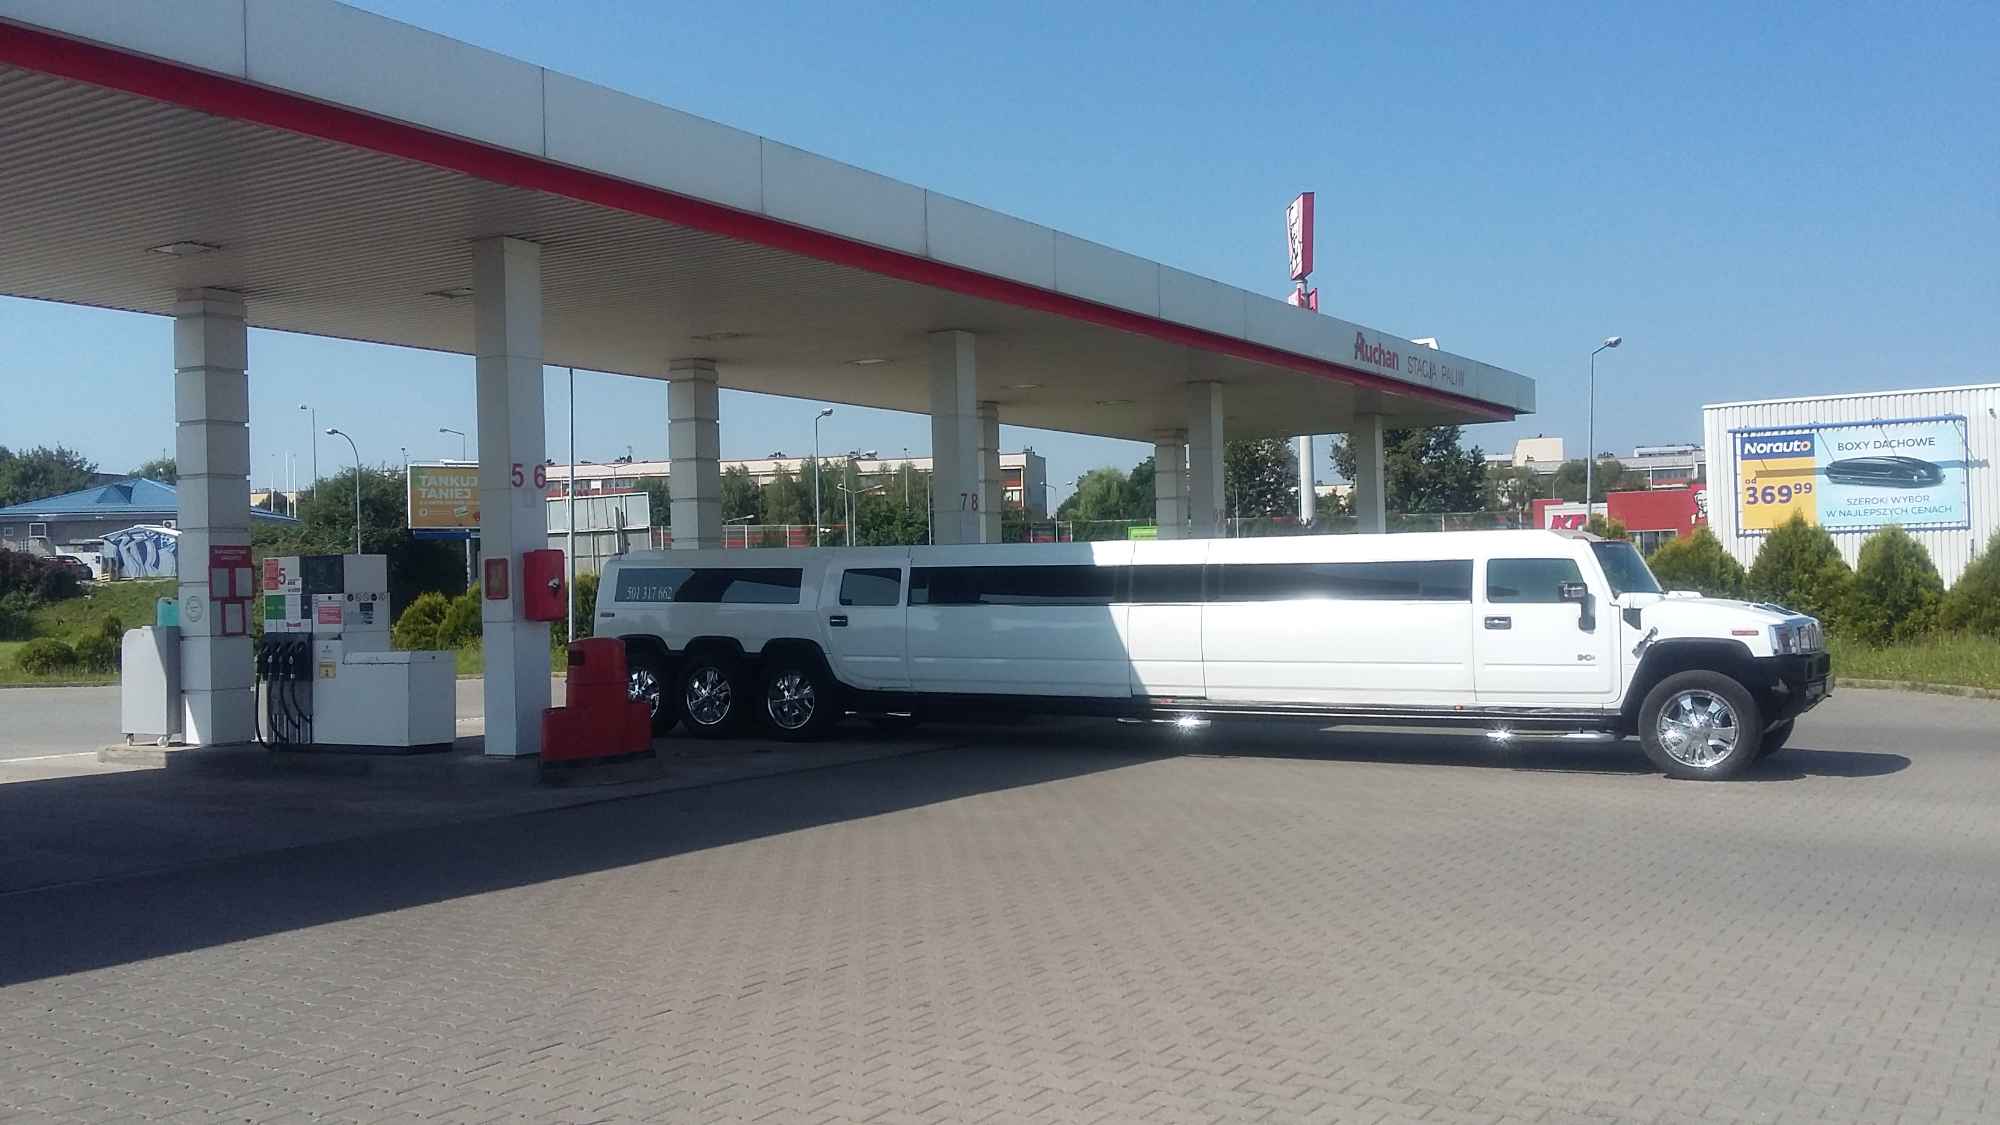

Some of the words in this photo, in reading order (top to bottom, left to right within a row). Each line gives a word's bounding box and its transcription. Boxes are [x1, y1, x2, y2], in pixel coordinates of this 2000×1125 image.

[1354, 331, 1399, 371] Auchan
[1407, 355, 1437, 380] STACJA
[1744, 440, 1811, 455] Norauto
[1837, 441, 1870, 452] BOXY
[1873, 437, 1936, 449] DACHOWE
[511, 463, 524, 487] 5
[534, 464, 546, 488] 6
[1745, 477, 1757, 485] od
[419, 488, 472, 498] TANIEJ
[960, 493, 967, 511] 7
[971, 493, 978, 511] 8
[1846, 497, 1888, 507] SZEROKI
[1826, 509, 1837, 519] W
[1838, 506, 1909, 518] NAJLEPSZYCH
[1910, 505, 1952, 515] CENACH
[278, 568, 286, 585] 5
[625, 586, 639, 600] 501
[642, 586, 657, 600] 317
